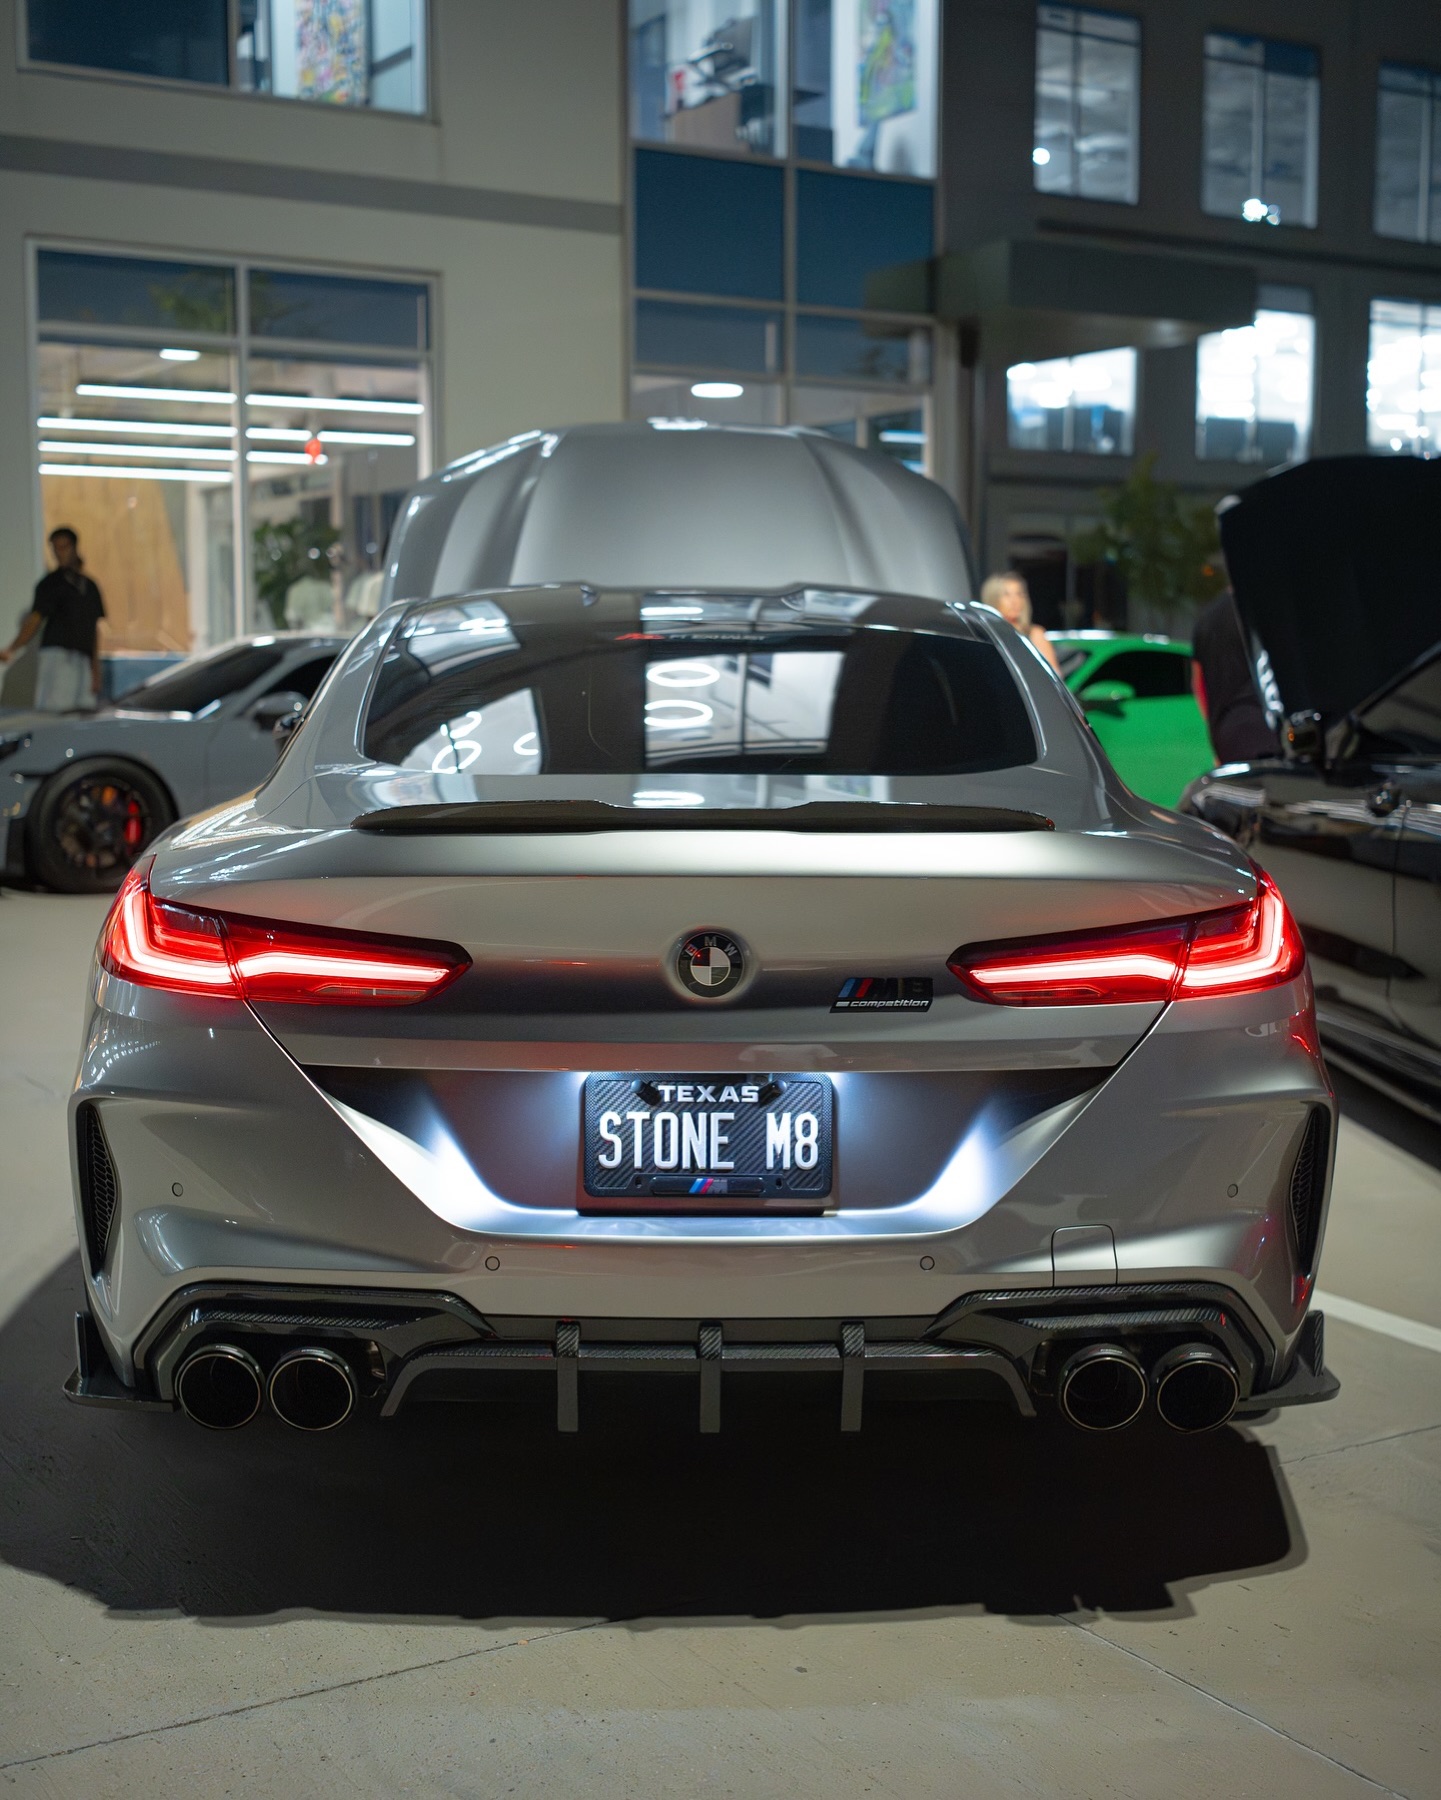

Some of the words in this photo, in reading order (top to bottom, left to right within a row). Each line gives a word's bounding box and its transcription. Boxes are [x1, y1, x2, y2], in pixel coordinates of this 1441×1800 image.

[684, 935, 738, 957] BMW
[866, 976, 933, 999] M8
[849, 999, 929, 1008] competition
[658, 1085, 759, 1103] TEXAS
[598, 1111, 735, 1170] STONE
[765, 1111, 819, 1170] M8
